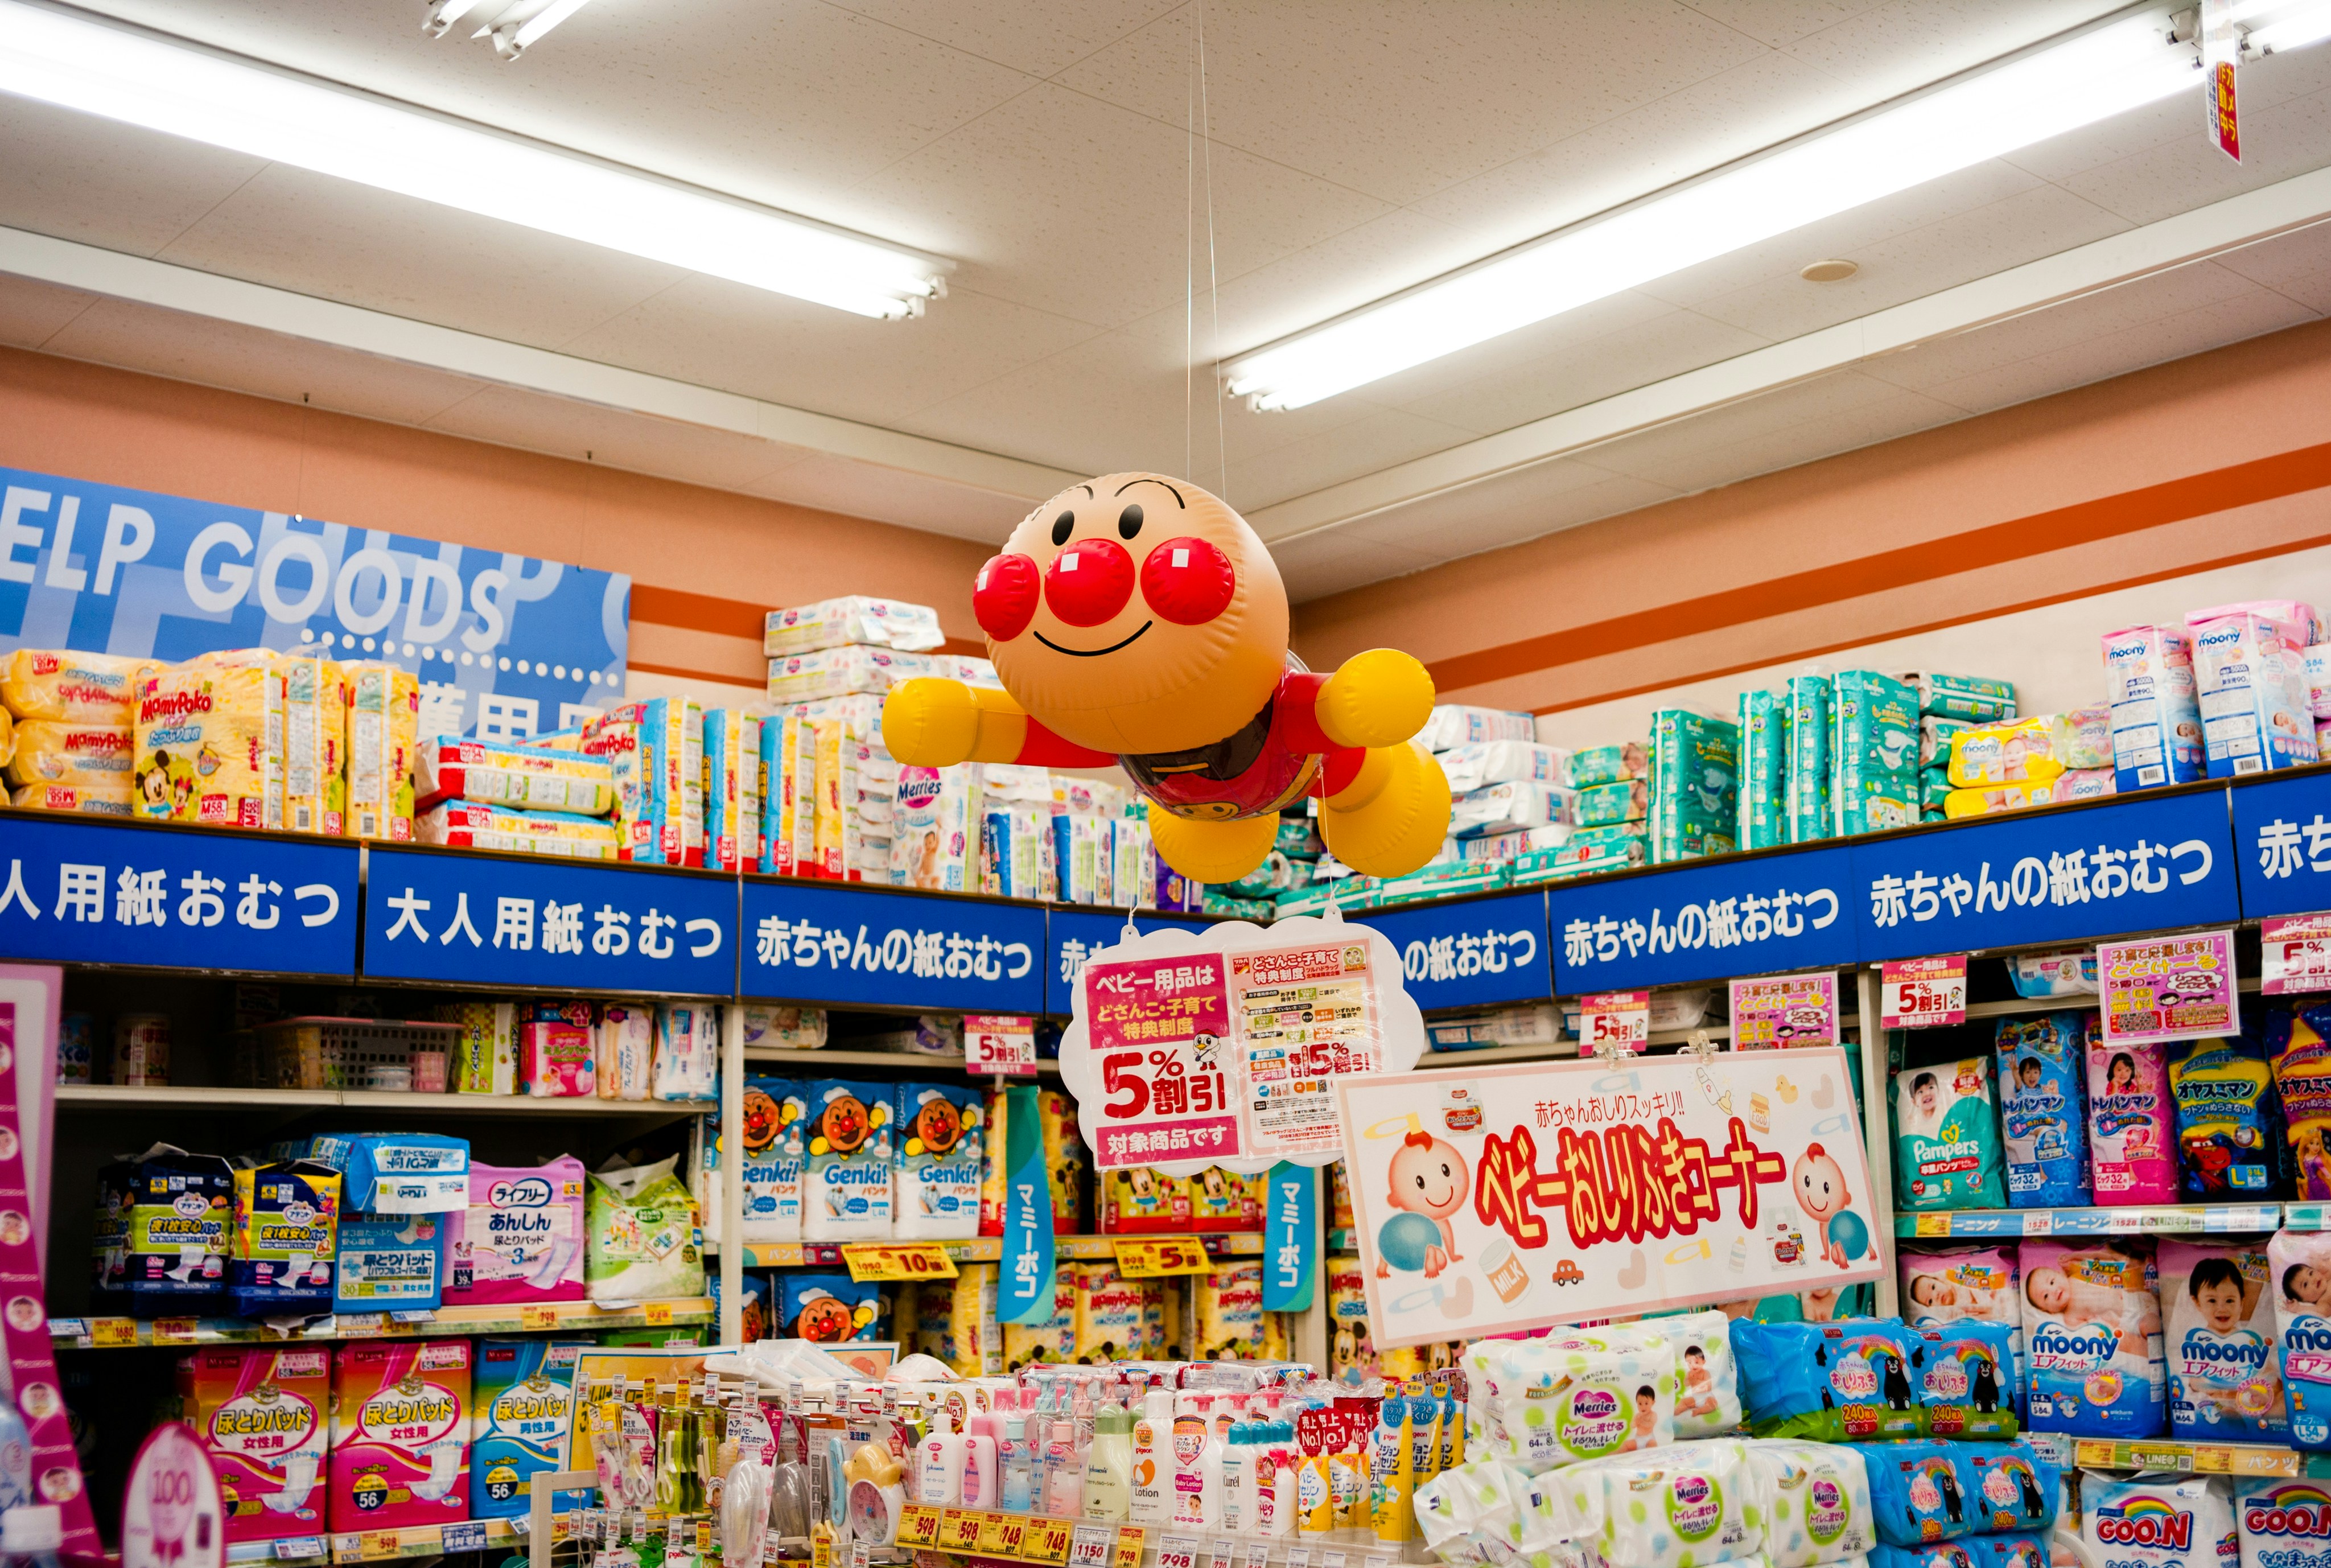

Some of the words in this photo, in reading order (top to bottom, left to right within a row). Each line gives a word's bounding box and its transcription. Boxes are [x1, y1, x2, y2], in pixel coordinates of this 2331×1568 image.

[184, 521, 509, 653] GOODS
[2199, 632, 2241, 647] moony
[2110, 645, 2146, 660] moony
[141, 690, 211, 723] MamyPoko
[1962, 742, 1999, 754] moony
[897, 776, 942, 802] Merries
[1870, 839, 2213, 927] 赤ちゃんの紙おむつ
[0, 859, 340, 929] 人用紙おむつ
[386, 887, 722, 958] 大人用紙おむつ
[1564, 888, 1839, 967] 赤ちゃんの紙おむつ
[756, 915, 1032, 980] 赤ちゃんの紙おむつ
[1403, 928, 1537, 982] の紙おむつ
[1253, 950, 1339, 970] どさんこ・子育て
[1306, 964, 1339, 973] ツルハドラッグ
[1900, 960, 1947, 972] ベビー用品は
[1096, 965, 1215, 993] ベビー用品は
[1254, 968, 1305, 984] 特典制度
[1899, 982, 1947, 1013] 5%割引
[1097, 995, 1217, 1022] どさんこ・子育て
[1123, 1018, 1195, 1040] 特典制度
[1103, 1048, 1226, 1118] 5%割引
[2178, 1083, 2254, 1098] オヤスミマン
[2003, 1097, 2065, 1112] トレパンマン
[2091, 1094, 2156, 1112] トレパンマン
[1752, 1112, 1767, 1126] FOOD
[1107, 1125, 1227, 1155] 対象商品です
[1913, 1139, 1979, 1163] Pampers
[825, 1164, 888, 1184] Genki!
[919, 1164, 979, 1184] Genki!
[1480, 1122, 1782, 1241] ベビーおしりふきコーナー
[2231, 1167, 2245, 1186] L
[496, 1188, 545, 1202] ライフリー
[770, 1185, 797, 1195] パンツ
[862, 1186, 888, 1196] パンツ
[953, 1186, 977, 1195] パンツ
[489, 1213, 552, 1232] あんしん
[2114, 1217, 2138, 1228] 1528
[493, 1234, 545, 1246] 尿とりパッド
[1014, 1184, 1039, 1298] マミーポコ
[1278, 1182, 1301, 1288] マミーポコ
[363, 1254, 433, 1267] 尿とりパッド
[898, 1253, 928, 1272] 10
[1160, 1248, 1183, 1269] 5
[1493, 1261, 1525, 1295] MILK
[1090, 1291, 1142, 1310] MamyPoko
[114, 1326, 134, 1338] 1680
[2032, 1335, 2118, 1360] moony
[2182, 1341, 2269, 1368] moony
[2033, 1355, 2088, 1370] エアフィット
[2182, 1360, 2240, 1377] エアフィット
[1830, 1372, 1877, 1390] おしりふき
[1924, 1373, 1968, 1393] おしりふき
[365, 1397, 454, 1426] 尿とりパッド
[496, 1393, 569, 1421] 尿とりパッ
[1385, 1407, 1402, 1415] ベタつき
[1574, 1402, 1617, 1416] Merries
[216, 1407, 311, 1434] 尿とりパッド
[520, 1421, 555, 1433] 男性用
[1302, 1415, 1317, 1429] 売上
[390, 1426, 429, 1439] 女性用
[1353, 1430, 1368, 1443] No.1
[1563, 1422, 1624, 1437] トイレに流せる
[242, 1435, 284, 1449] 女性用
[1302, 1431, 1320, 1447] No.1
[1572, 1433, 1618, 1445] するりんキレイ
[2146, 1455, 2176, 1466] LINE@
[2248, 1455, 2296, 1471] パンツ
[1131, 1478, 1143, 1489] Baby
[1224, 1475, 1239, 1487] Curél
[1300, 1474, 1316, 1483] ベビー
[1135, 1487, 1159, 1498] Lotion
[1677, 1484, 1708, 1501] Merries
[1814, 1492, 1839, 1504] Merries
[1674, 1505, 1718, 1522] トイレに流せる
[1810, 1512, 1845, 1524] トイレに流せる
[917, 1516, 936, 1536] 598
[959, 1521, 979, 1541] 598
[1002, 1525, 1021, 1545] 748
[1046, 1531, 1066, 1551] 748
[1077, 1544, 1104, 1557] 1150
[1119, 1550, 1136, 1561] 798
[1161, 1554, 1191, 1567] 798
